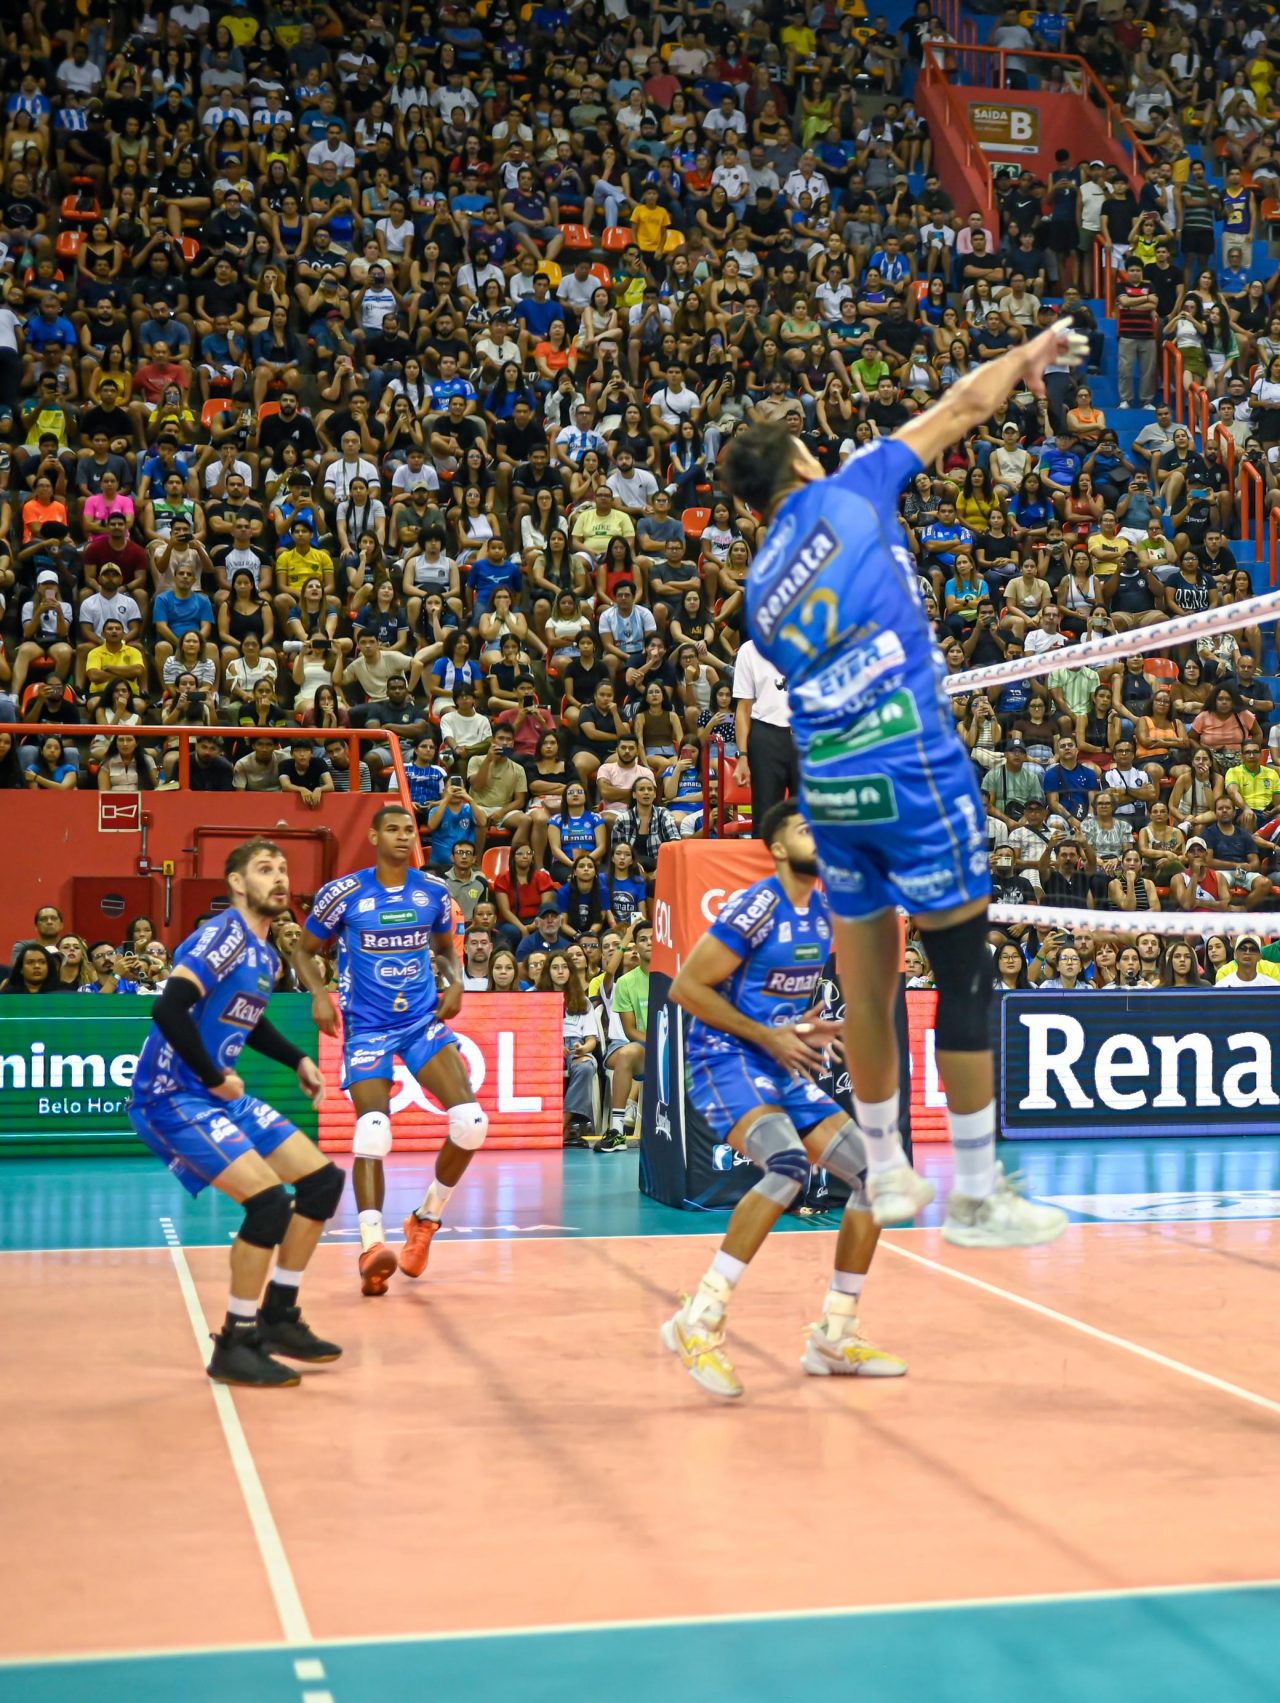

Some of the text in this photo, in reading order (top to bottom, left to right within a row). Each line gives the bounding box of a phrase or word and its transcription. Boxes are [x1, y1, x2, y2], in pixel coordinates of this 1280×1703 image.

[1010, 113, 1033, 141] B
[757, 533, 834, 637] Renata
[780, 587, 839, 657] 12
[312, 875, 357, 918] Renata
[363, 930, 429, 949] Renata
[655, 898, 673, 949] GOL
[380, 964, 418, 978] EMS
[0, 1041, 143, 1089] nime
[38, 1097, 81, 1114] Belo
